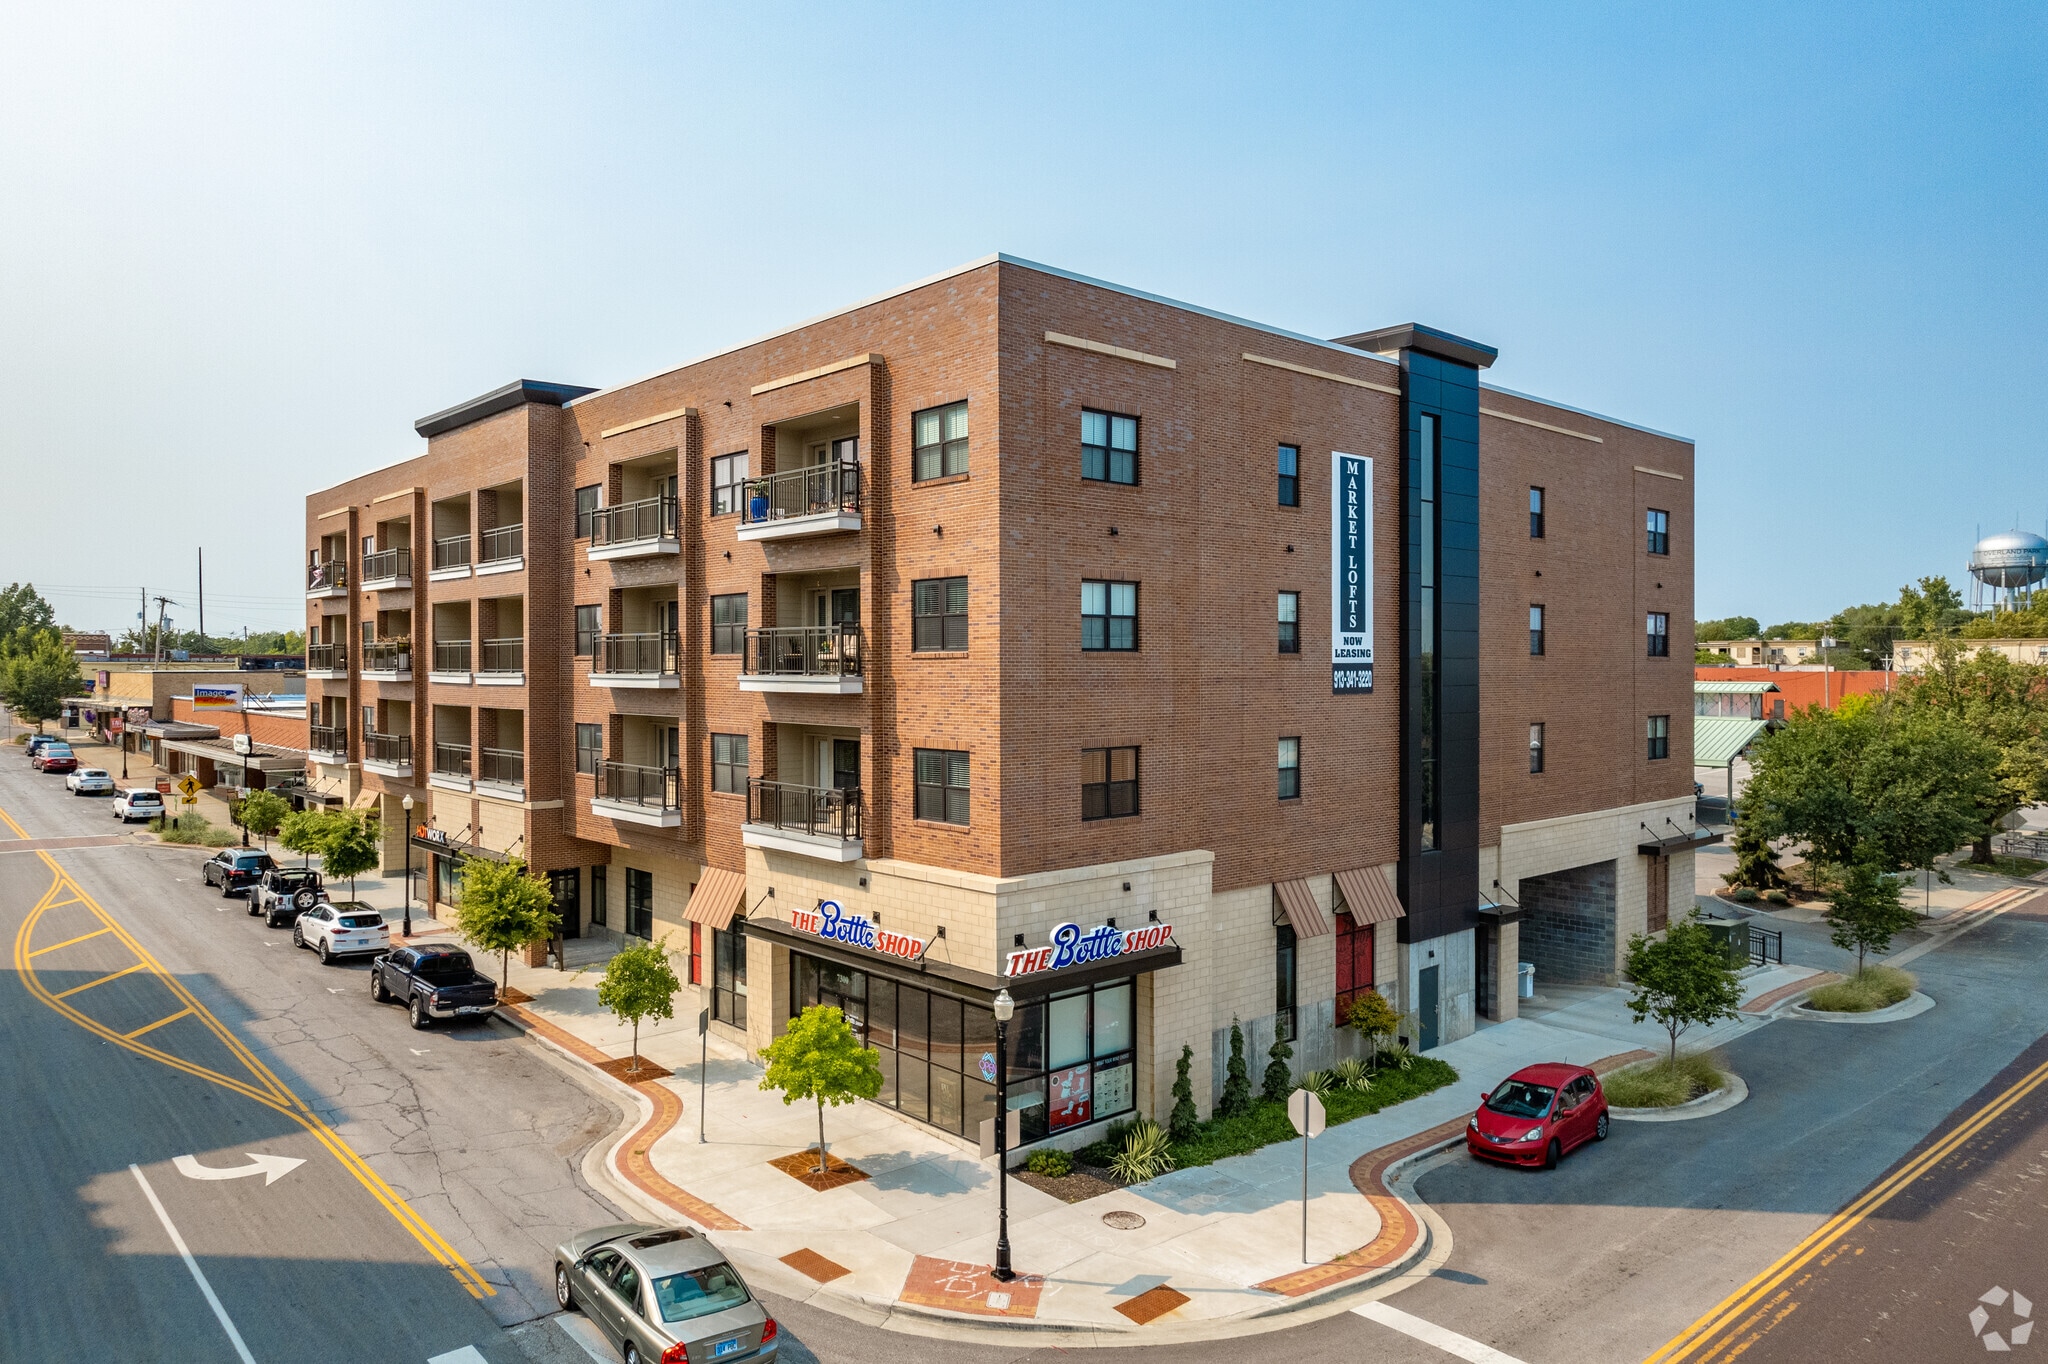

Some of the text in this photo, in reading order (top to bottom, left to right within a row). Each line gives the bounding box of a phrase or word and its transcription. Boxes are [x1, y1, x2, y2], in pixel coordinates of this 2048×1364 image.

[1347, 460, 1359, 628] MARKET LOFTS
[1343, 636, 1363, 646] NOW
[1335, 649, 1372, 658] LEASING
[196, 689, 227, 698] Images
[416, 825, 447, 844] HOTWORX
[791, 900, 922, 959] THE Bottle SHOP
[1009, 923, 1173, 977] THE Bottle SHOP
